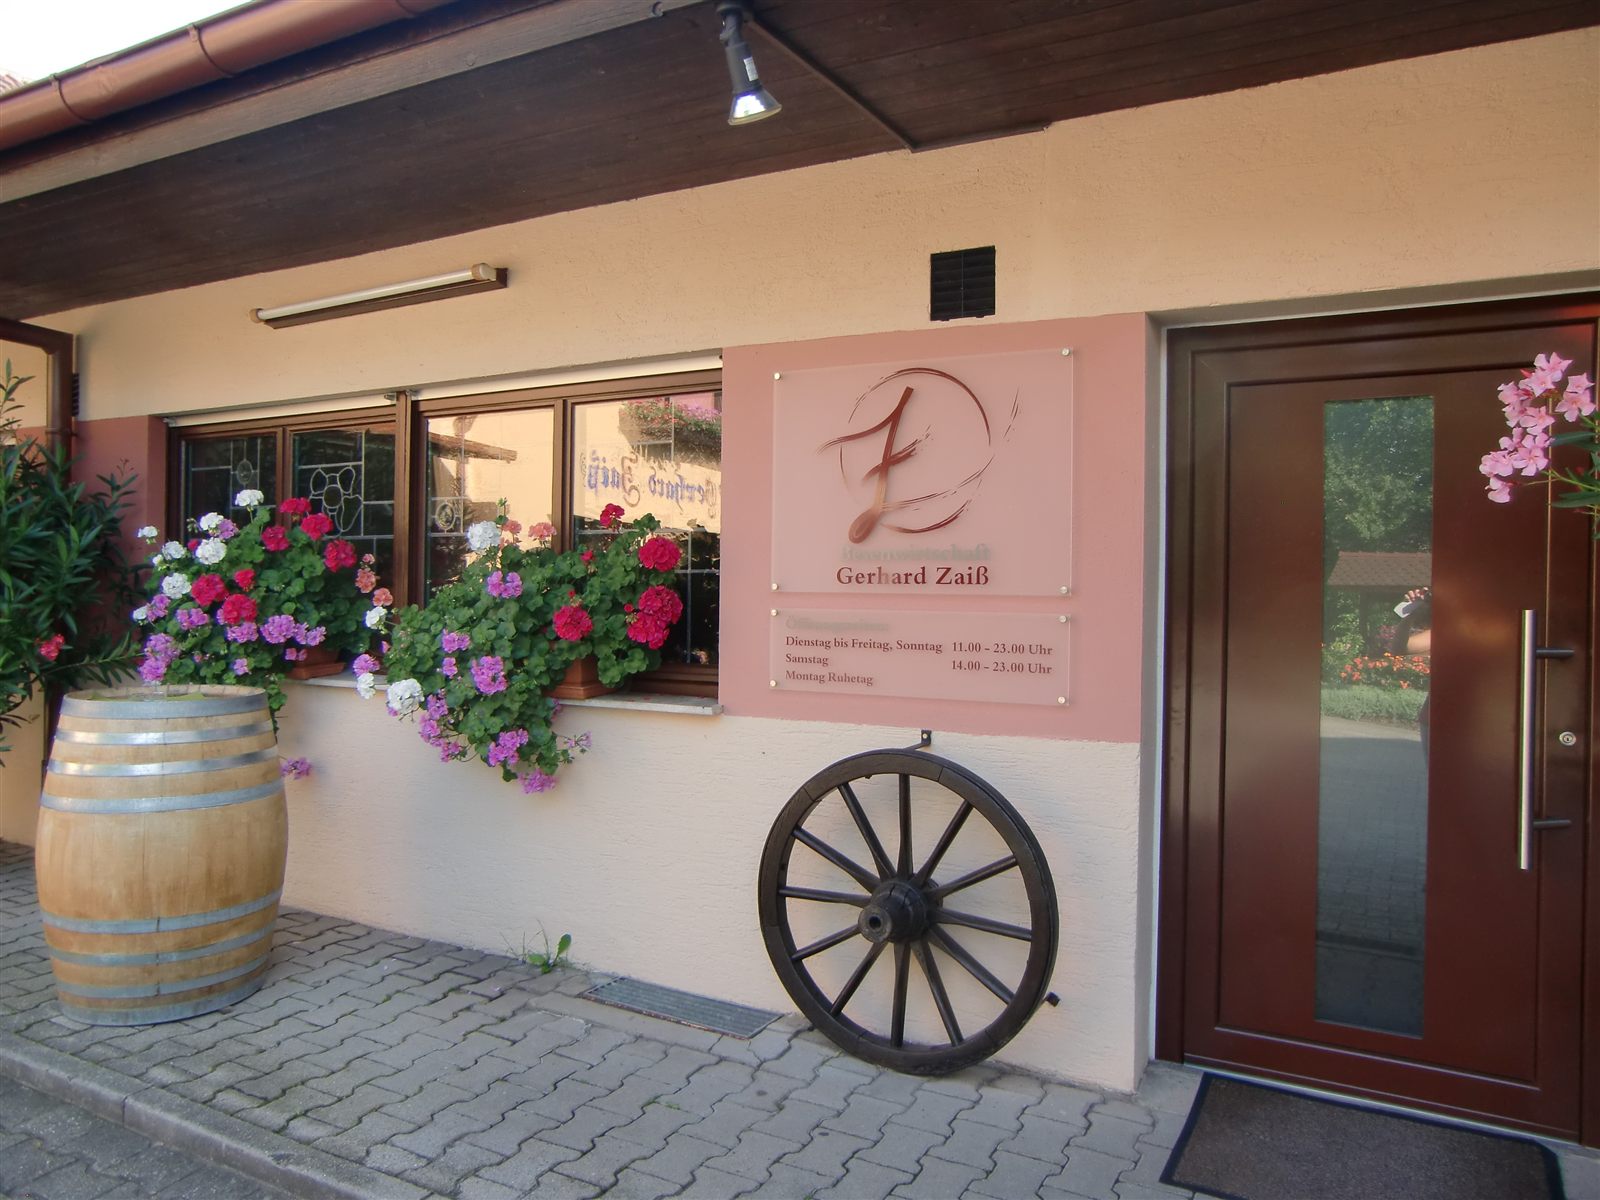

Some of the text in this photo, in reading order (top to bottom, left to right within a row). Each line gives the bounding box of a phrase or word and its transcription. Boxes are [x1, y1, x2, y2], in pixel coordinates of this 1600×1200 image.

[836, 566, 989, 586] Gerhard Zaiß
[785, 636, 831, 650] Dienstag
[834, 637, 849, 648] bis
[851, 638, 893, 652] Freitag,
[896, 639, 943, 654] Sonntag
[952, 641, 981, 653] 11.00
[993, 643, 1025, 654] 23.00
[1028, 644, 1053, 655] Uhr
[785, 653, 829, 667] Samstag
[952, 660, 981, 671] 14.00
[992, 661, 1024, 673] 23.00
[1028, 662, 1053, 674] Uhr
[785, 670, 874, 686] Montag Ruhetag
